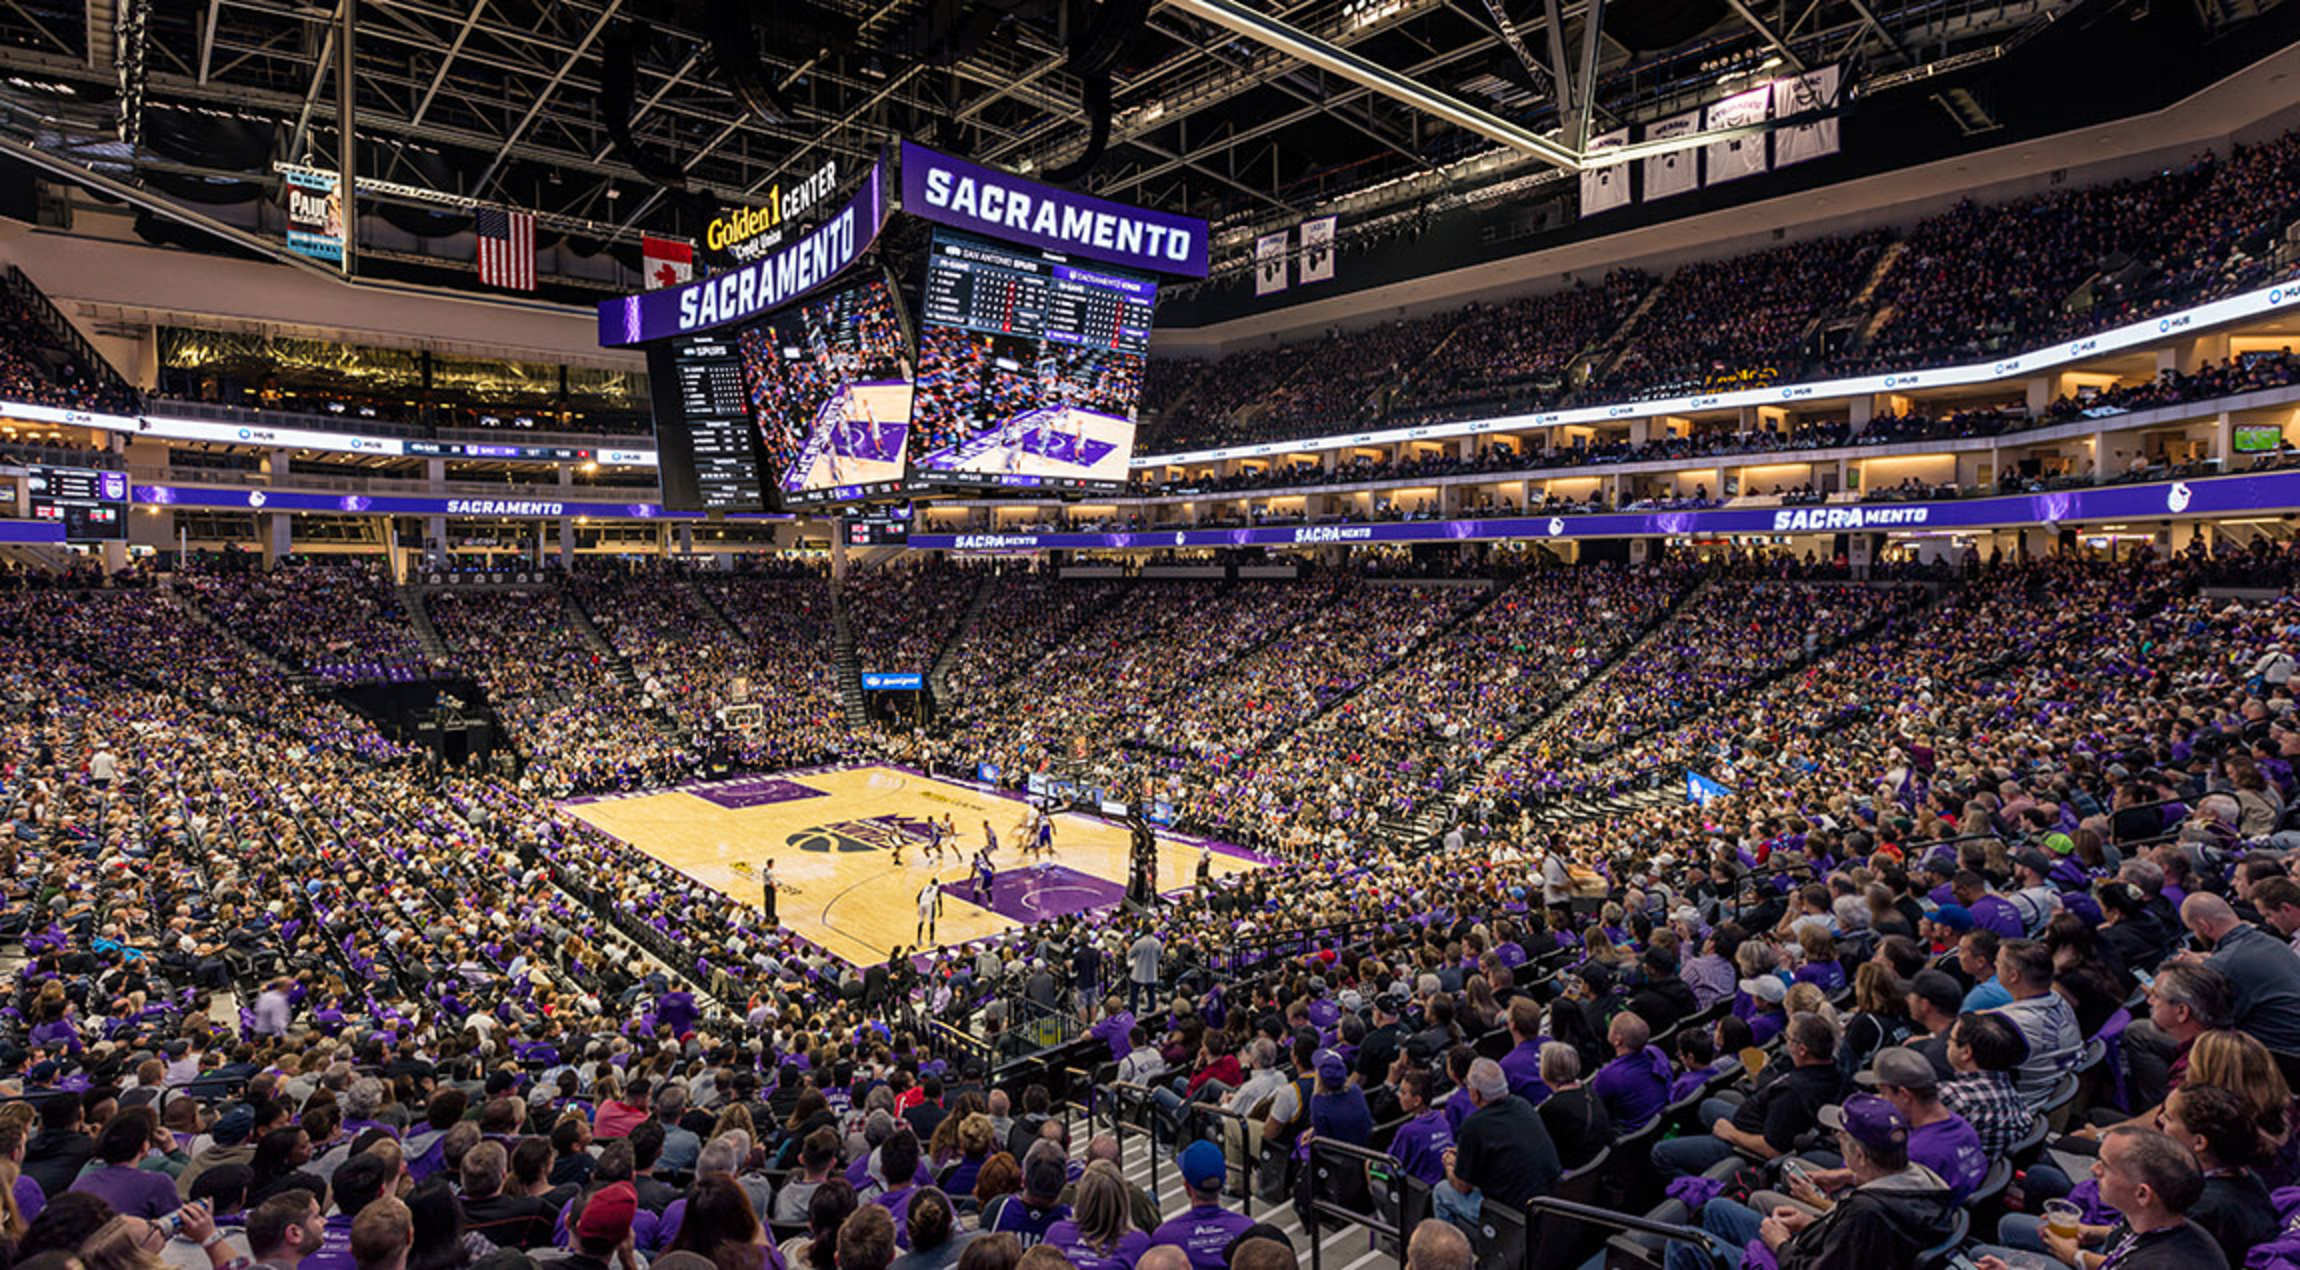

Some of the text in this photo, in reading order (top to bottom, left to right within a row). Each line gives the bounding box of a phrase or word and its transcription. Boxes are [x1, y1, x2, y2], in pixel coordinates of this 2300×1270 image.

[1667, 157, 1675, 168] 4
[707, 160, 837, 251] Golden 1 CENTER
[924, 167, 1191, 262] SACRAMENTO
[679, 205, 855, 330] SACRAMENTO
[2282, 286, 2300, 299] HU
[2170, 314, 2190, 328] HUB
[447, 500, 563, 516] SACRAMENTO
[1773, 506, 1928, 531] SACRAMENTO
[955, 535, 1037, 549] SACRAMENTO
[1294, 527, 1372, 542] SACRAMENTO
